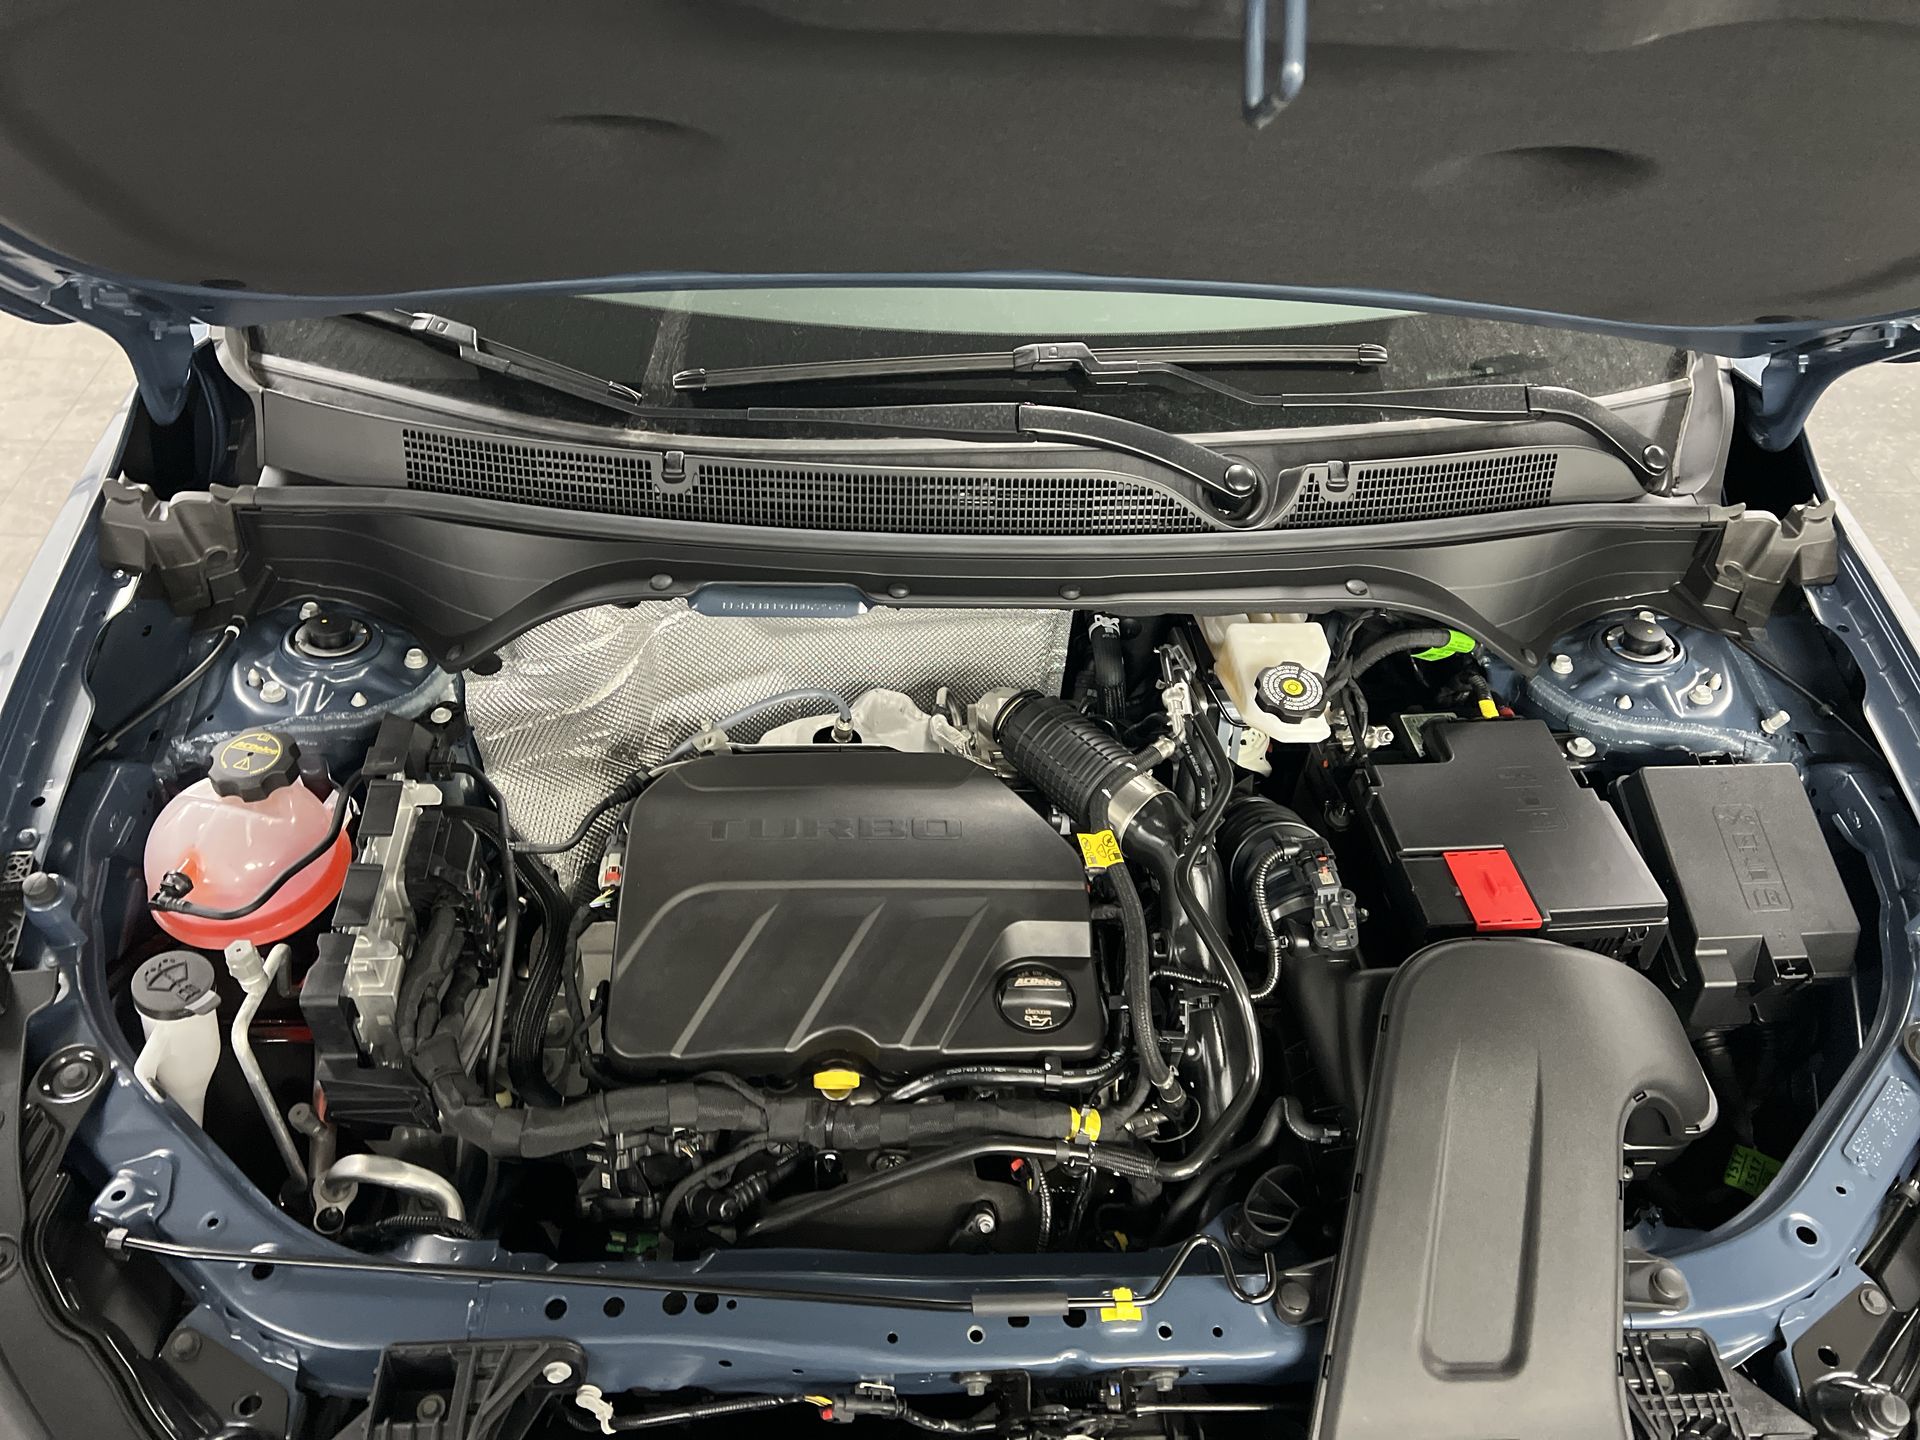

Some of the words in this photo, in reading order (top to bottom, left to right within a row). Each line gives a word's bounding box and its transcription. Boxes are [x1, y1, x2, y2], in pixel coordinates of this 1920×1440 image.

[696, 816, 962, 842] TURBO
[1014, 977, 1062, 987] ACDelco
[1025, 1008, 1052, 1016] dexos
